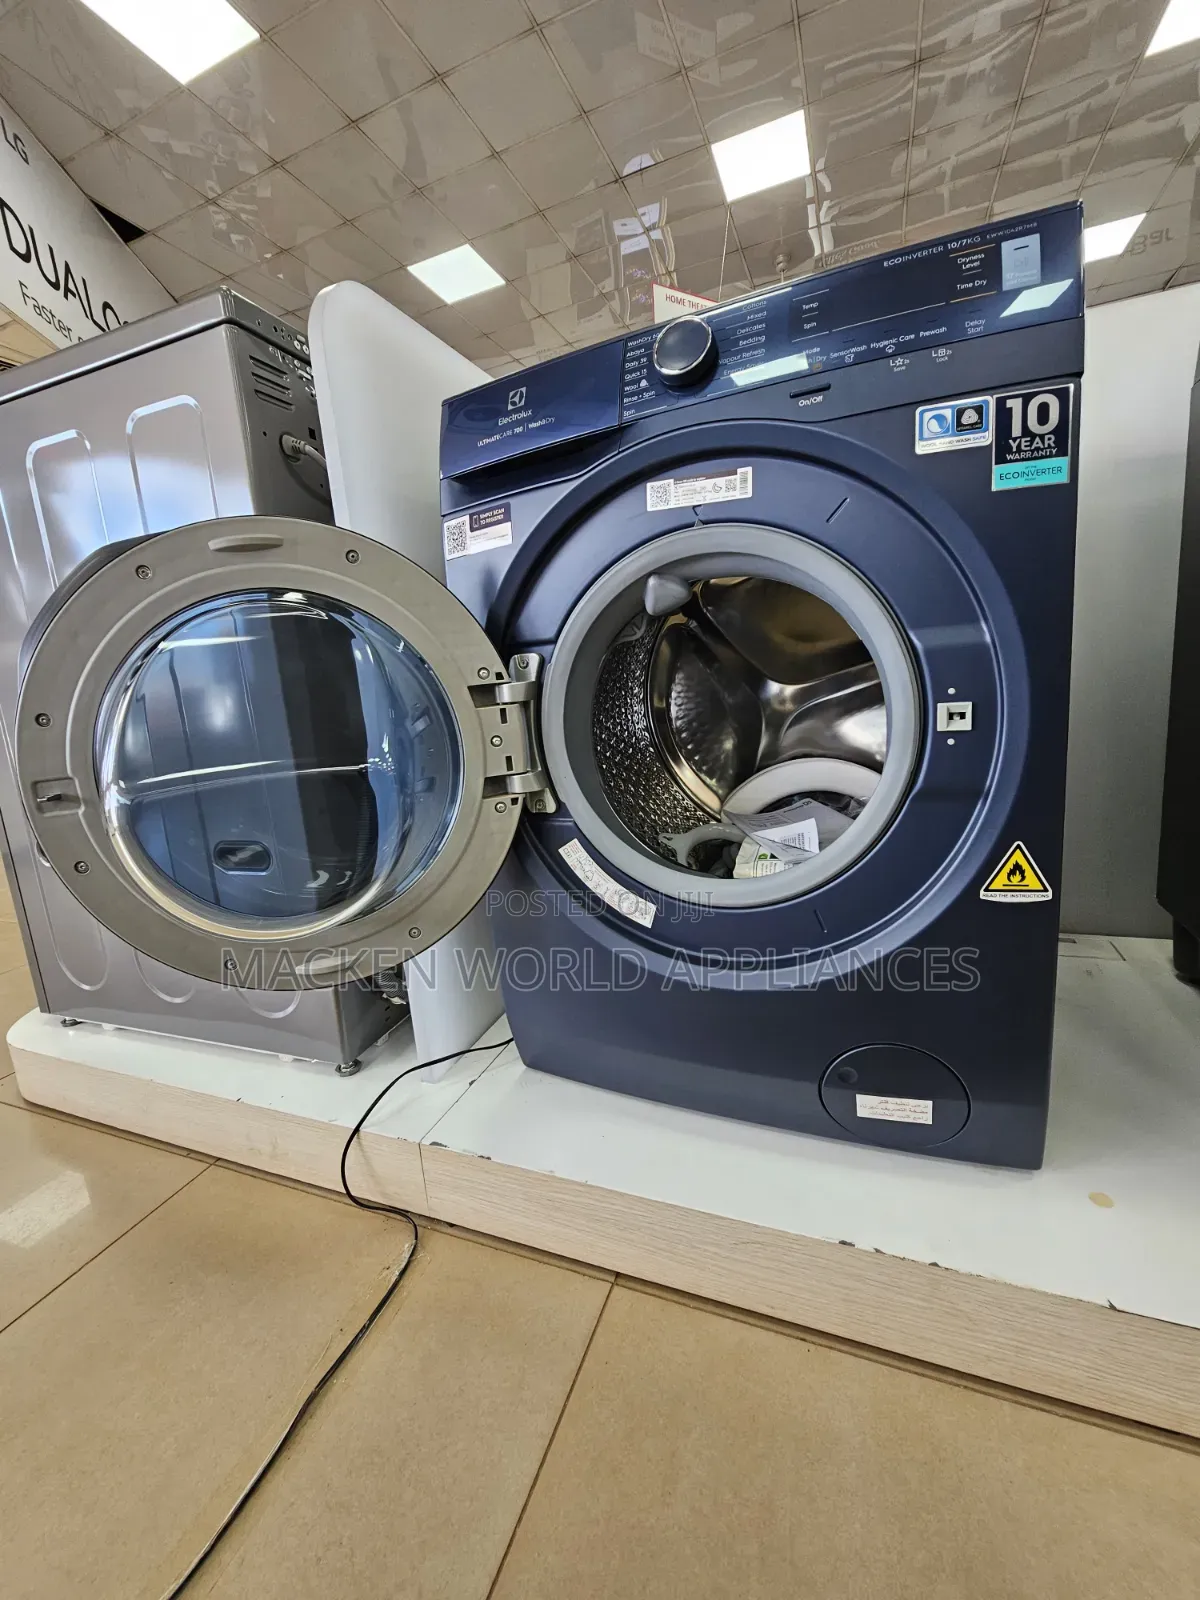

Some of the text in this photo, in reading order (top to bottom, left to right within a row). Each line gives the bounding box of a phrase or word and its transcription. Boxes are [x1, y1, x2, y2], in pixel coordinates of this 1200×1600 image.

[0, 115, 29, 166] LG
[883, 245, 944, 268] ECOINVERTER
[947, 235, 982, 250] 10/7KG
[957, 252, 985, 264] Dryness
[962, 260, 981, 270] Level
[956, 279, 988, 291] Time Dry
[665, 293, 686, 307] HOME
[18, 279, 73, 342] Faster
[802, 302, 819, 311] Temp
[747, 311, 767, 320] Mixed
[736, 322, 766, 335] Delicates
[803, 321, 817, 330] Spin
[965, 318, 986, 328] Delay
[919, 326, 947, 338] Prewash
[967, 325, 984, 334] Start
[739, 335, 766, 346] Bedding
[870, 333, 915, 349] Hygienic Care
[626, 348, 645, 357] Abaya
[742, 348, 766, 359] Refresh
[830, 344, 868, 359] SensorWash
[625, 361, 639, 369] Daily
[936, 355, 948, 363] Lock
[893, 364, 906, 372] Save
[624, 371, 640, 380] Quick
[624, 383, 639, 391] Wool
[623, 396, 638, 404] Rinse
[643, 390, 656, 398] Spin
[798, 395, 824, 407] On/Off
[498, 409, 533, 426] Electrolux
[623, 408, 636, 417] Spin
[1006, 393, 1060, 437] 10
[513, 427, 523, 435] 700
[1008, 434, 1055, 452] YEAR
[1005, 447, 1058, 461] WARRANTY
[999, 465, 1062, 481] ECOINVERTER
